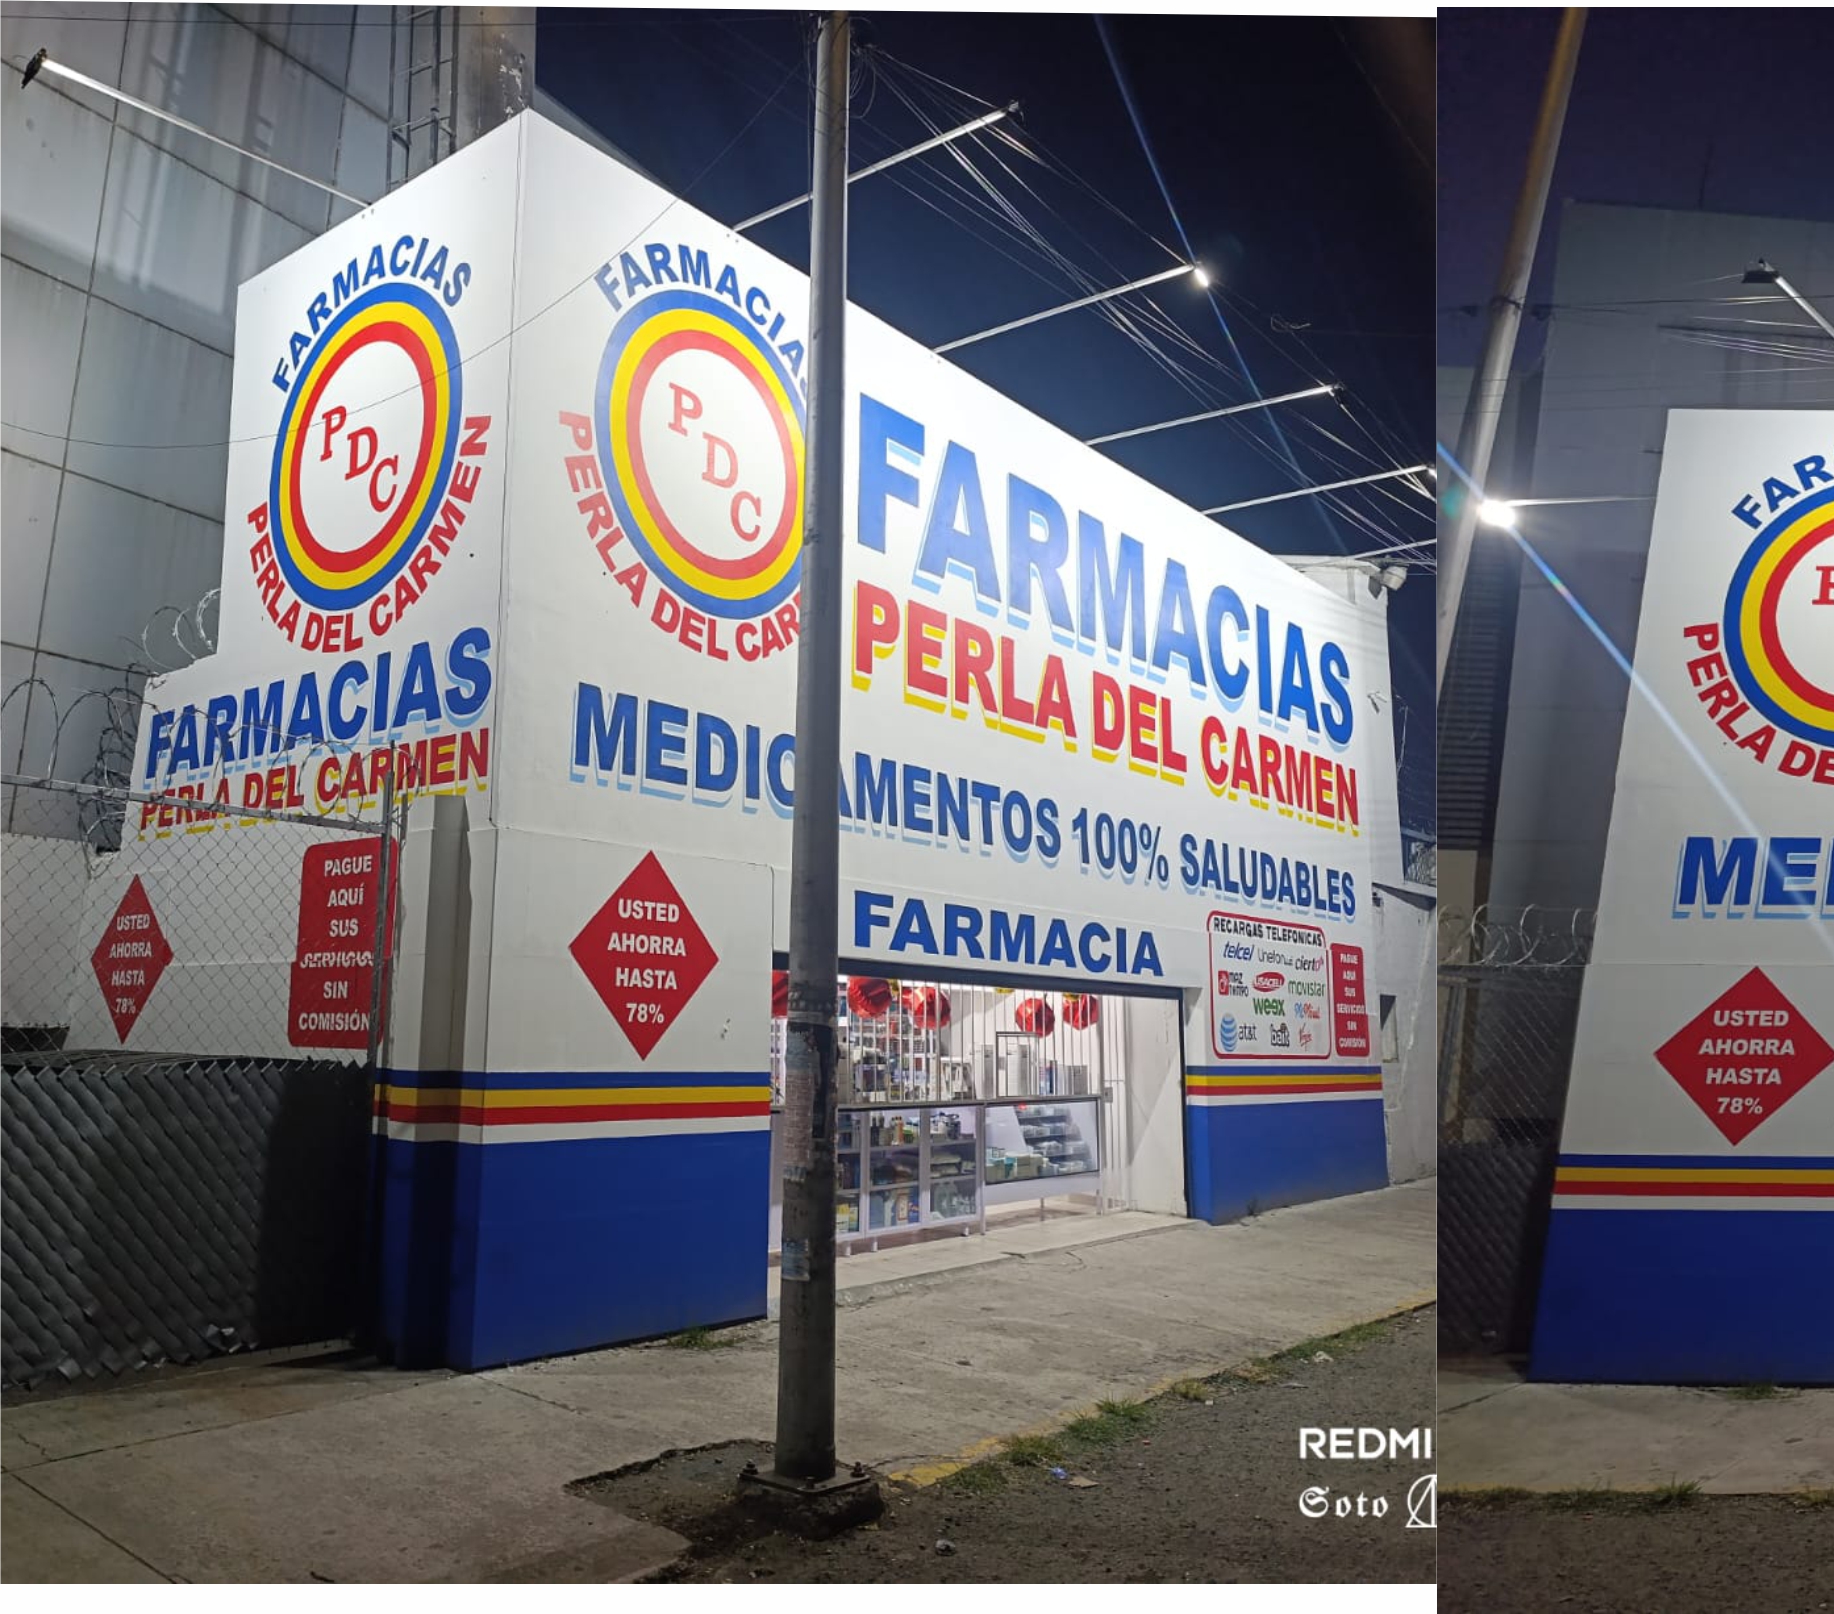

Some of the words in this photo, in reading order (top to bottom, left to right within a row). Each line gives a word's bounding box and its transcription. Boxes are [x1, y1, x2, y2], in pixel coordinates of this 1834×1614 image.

[271, 235, 472, 393] FARMACIAS
[594, 243, 808, 390] FARMACIA
[247, 502, 302, 642] PERLA
[301, 612, 364, 653] DEL
[369, 415, 492, 636] CARMEN
[559, 410, 651, 608] PERLA
[651, 587, 730, 662] DEL
[735, 591, 802, 662] CAR
[857, 391, 1355, 750] FARMACIAS
[145, 627, 492, 782] FARMACIAS
[1683, 621, 1782, 764] PERLA
[854, 580, 1078, 745] PERLA
[1092, 671, 1188, 778] DEL
[1201, 716, 1360, 830] CARMEN
[243, 766, 304, 811] DEL
[316, 728, 490, 803] CARMEN
[573, 681, 1061, 860] MEDICMENTOS
[1072, 808, 1169, 884] 100%
[1179, 833, 1357, 920] SALUDABLES
[324, 855, 373, 877] PAGUE
[327, 883, 365, 908] AQUÍ
[116, 914, 150, 931] USTED
[617, 898, 680, 923] USTED
[329, 918, 359, 938] SUS
[853, 890, 1165, 977] FARMACIA
[1214, 917, 1264, 939] RECARGAS
[1266, 925, 1323, 947] TELEFONICAS
[109, 941, 152, 959] AHORRA
[607, 932, 687, 957] AHORRA
[1223, 941, 1255, 961] telcel
[111, 970, 146, 987] HASTA
[323, 981, 348, 999] SIN
[615, 966, 678, 990] HASTA
[1288, 979, 1326, 997] movistar
[115, 998, 137, 1014] 78%
[626, 1002, 665, 1024] 78%
[1252, 998, 1286, 1016] weex
[299, 1009, 369, 1031] COMISIÓN
[1713, 1009, 1790, 1028] USTED
[1270, 1023, 1290, 1047] bait
[1699, 1038, 1796, 1057] AHORRA
[1705, 1067, 1782, 1086] HASTA
[1717, 1096, 1763, 1115] 78%
